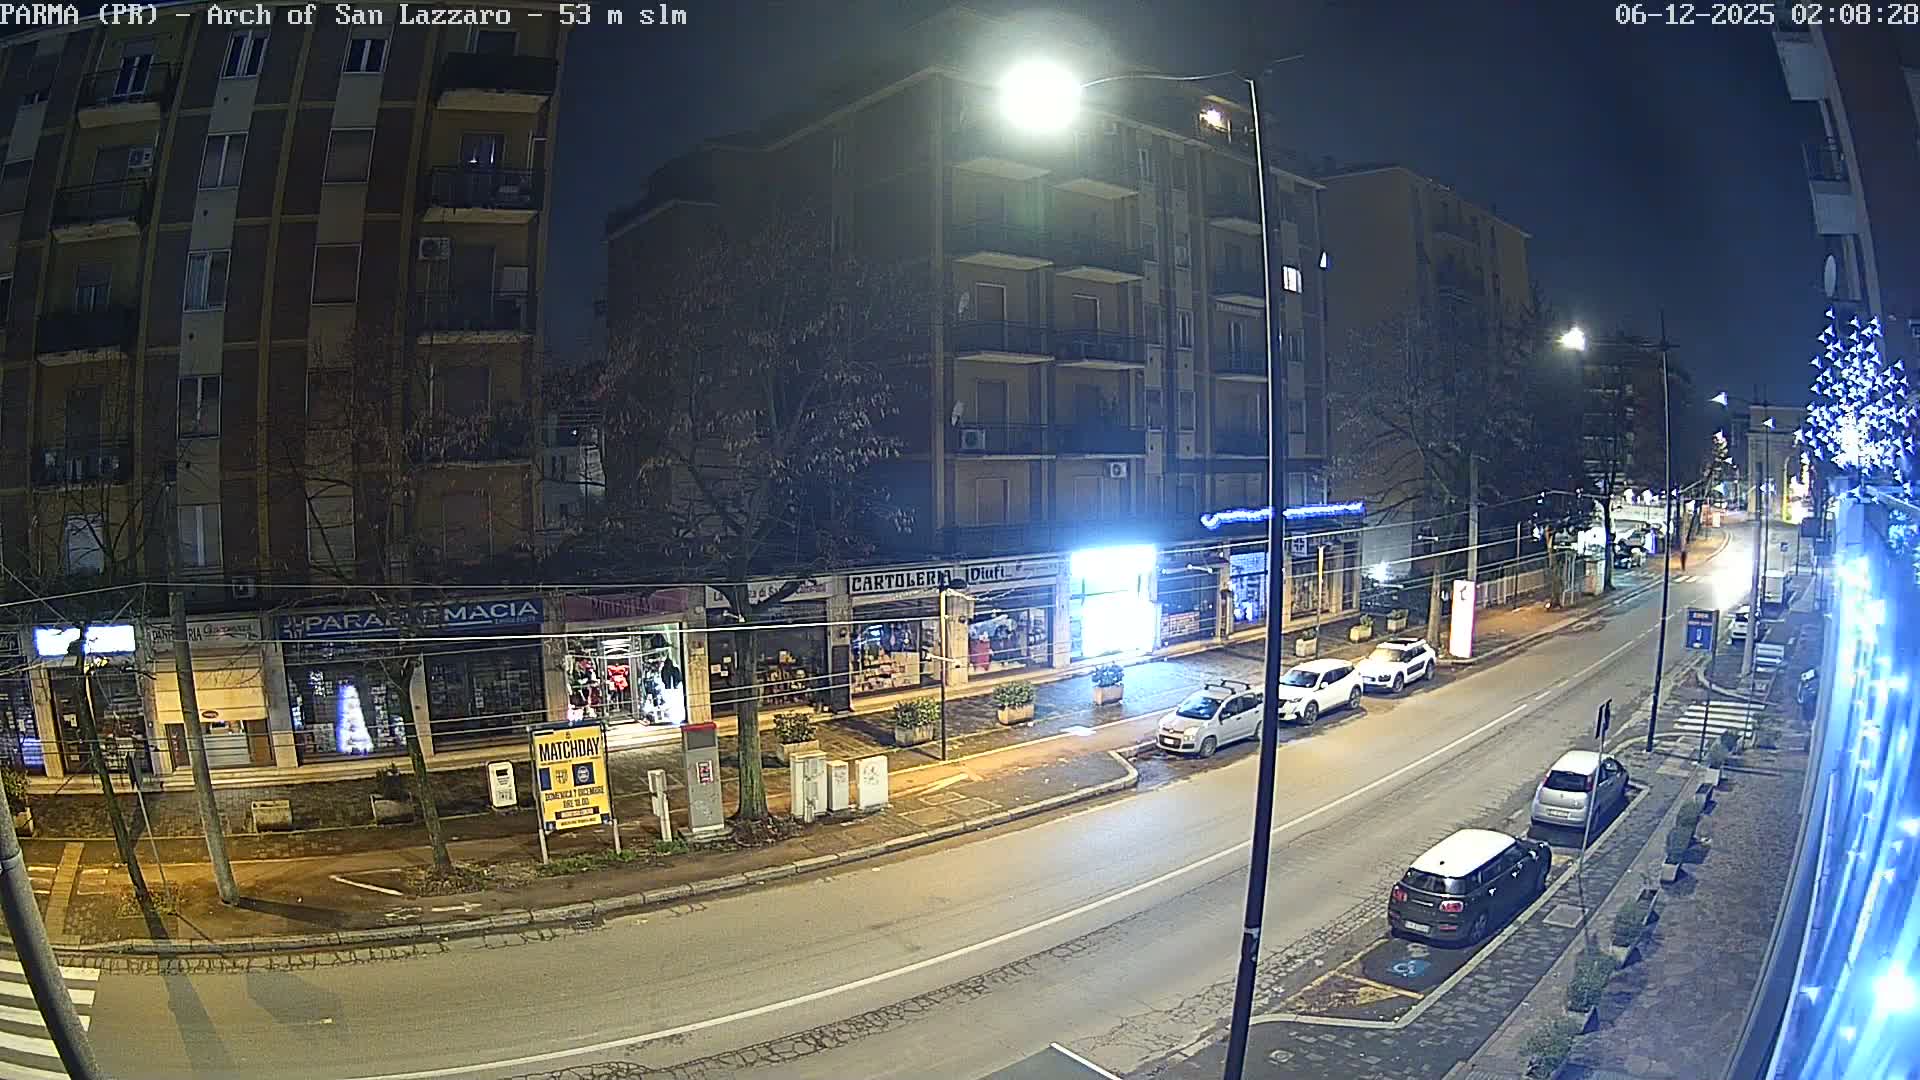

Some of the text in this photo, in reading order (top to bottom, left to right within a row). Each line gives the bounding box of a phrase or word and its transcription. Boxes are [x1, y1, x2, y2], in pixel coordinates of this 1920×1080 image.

[852, 569, 951, 592] CARTOLERIA
[305, 601, 538, 631] PARAMACIA
[538, 737, 600, 762] MATCHDAY
